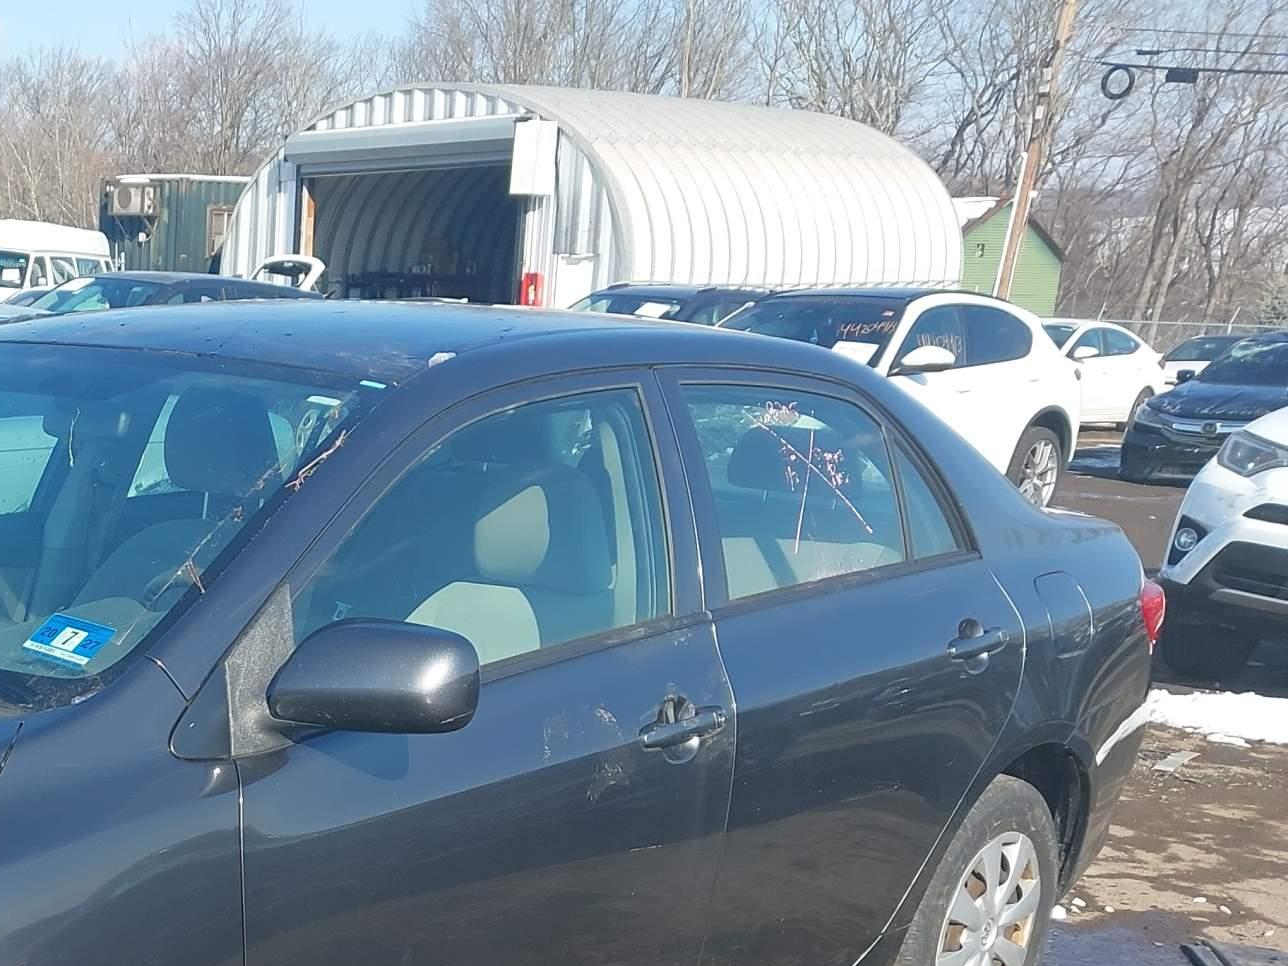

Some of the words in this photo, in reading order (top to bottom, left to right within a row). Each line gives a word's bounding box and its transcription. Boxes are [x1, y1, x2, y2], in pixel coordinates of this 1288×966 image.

[40, 626, 58, 639] 20
[61, 631, 79, 646] 7
[81, 639, 102, 651] 27
